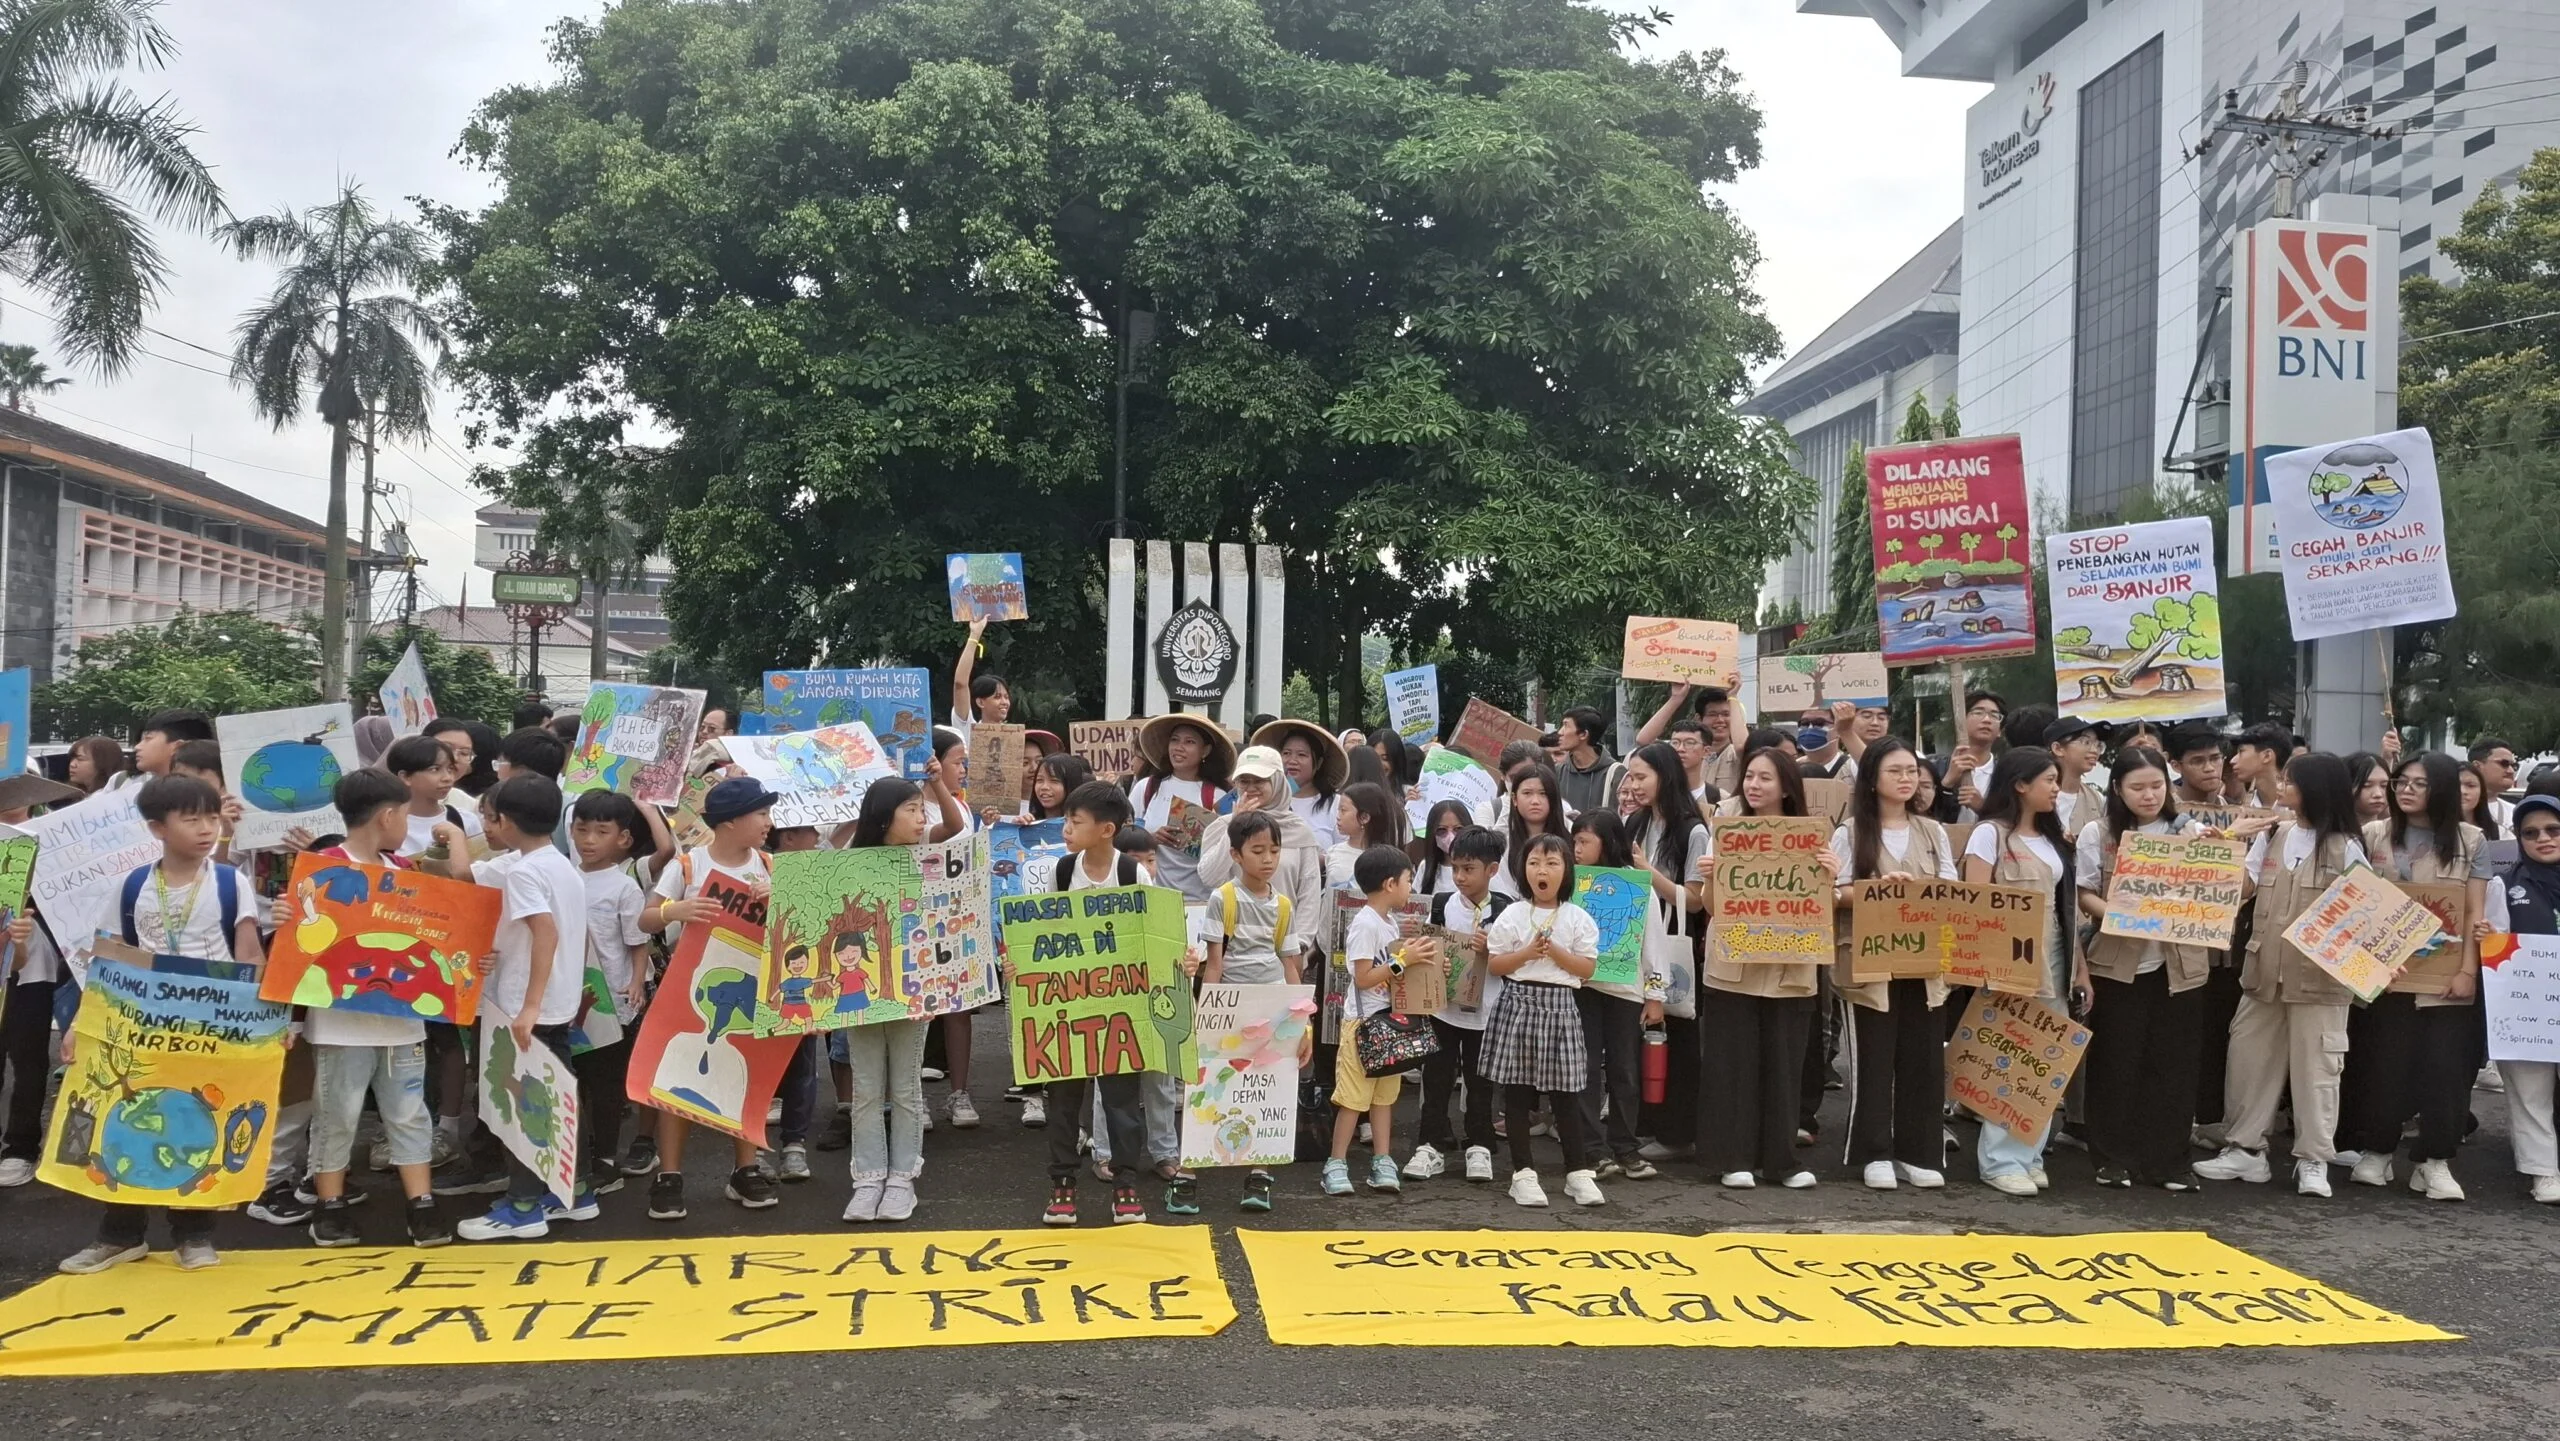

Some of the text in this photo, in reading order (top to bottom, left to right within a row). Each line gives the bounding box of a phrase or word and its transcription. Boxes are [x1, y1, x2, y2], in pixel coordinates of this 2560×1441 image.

[2278, 336, 2365, 380] BNI
[1885, 456, 1990, 481] DILARANG
[1882, 477, 1968, 498] MEMBUANG
[1884, 492, 1968, 510] SAMPAH
[1887, 502, 1999, 530] DI SUNGAI
[2069, 533, 2129, 555] STOP
[2291, 522, 2426, 558] CEGAH BANJIR
[2057, 543, 2200, 572] PENEBANGAN HUTAN
[2320, 543, 2392, 564] mulai dari
[2080, 559, 2201, 583] SELAMATKAN BUMI
[2067, 574, 2192, 602] DARI BANJIR
[2307, 573, 2438, 601] BERSIHKAN LINGKUNGAN SEKITAR
[2310, 609, 2333, 620] TANAM
[2336, 605, 2361, 616] POHON
[2364, 598, 2402, 611] PENCEGAH
[1162, 609, 1232, 660] UNIVERSITAS DIPONEGORO
[1644, 638, 1718, 662] Semarang
[805, 673, 922, 686] BUMI RUMAH KITA
[1395, 674, 1425, 687] MANGROVE
[1672, 664, 1716, 678] Sejarah
[798, 686, 921, 699] JANGAN DIRUSAK
[1176, 687, 1221, 698] SEMARANG
[1397, 689, 1430, 703] KOMODITAS
[1402, 682, 1423, 692] BUKAN
[1768, 684, 1798, 694] HEAL
[1841, 679, 1879, 688] WORLD
[1403, 705, 1428, 717] BENTENG
[1408, 698, 1421, 707] TAPI
[1401, 713, 1432, 726] KEHIDUPAN
[1073, 726, 1127, 745] UDAH
[771, 808, 803, 826] AYO
[40, 821, 82, 850] UMI
[248, 822, 289, 836] WAKTU
[1722, 832, 1825, 852] SAVE OUR
[38, 863, 106, 901] BUKAN
[1728, 864, 1807, 892] Earth
[2119, 879, 2173, 897] ASAP
[899, 873, 981, 917] banyak
[1864, 883, 2034, 912] AKU ARMY BTS
[1004, 890, 1148, 926] MASA DEPAN
[1722, 898, 1823, 917] SAVE OUR
[1897, 903, 2007, 932] hari ini jadi
[2317, 896, 2352, 931] KAMU
[902, 932, 977, 973] Lebih
[1033, 932, 1084, 963] ADA
[1861, 931, 1926, 957] ARMY
[2374, 938, 2401, 964] Bukan
[2531, 949, 2558, 959] BUMI
[902, 958, 980, 998] banyak
[1016, 962, 1150, 1008] TANGAN
[2512, 969, 2560, 981] KITA KU
[99, 965, 288, 1023] KURANGI SAMPAH MAKANAN!
[1201, 990, 1240, 1009] AKU
[119, 1001, 253, 1044] KURANGI JEJAK
[1196, 1013, 1236, 1031] INGIN
[2547, 1017, 2560, 1026] Ca
[126, 1029, 220, 1055] KARBON.
[2509, 1034, 2554, 1045] Spirulina
[1242, 1073, 1277, 1089] MASA
[1232, 1089, 1267, 1104] DEPAN
[1953, 1076, 2035, 1133] GHOSTING
[1259, 1107, 1288, 1122] YANG
[559, 1091, 576, 1190] HIJAU
[1256, 1127, 1288, 1139] HIJAU
[267, 1238, 1073, 1294] SEMARANG
[1324, 1240, 1699, 1277] Semarang
[1499, 1281, 2092, 1327] Kalau Kita
